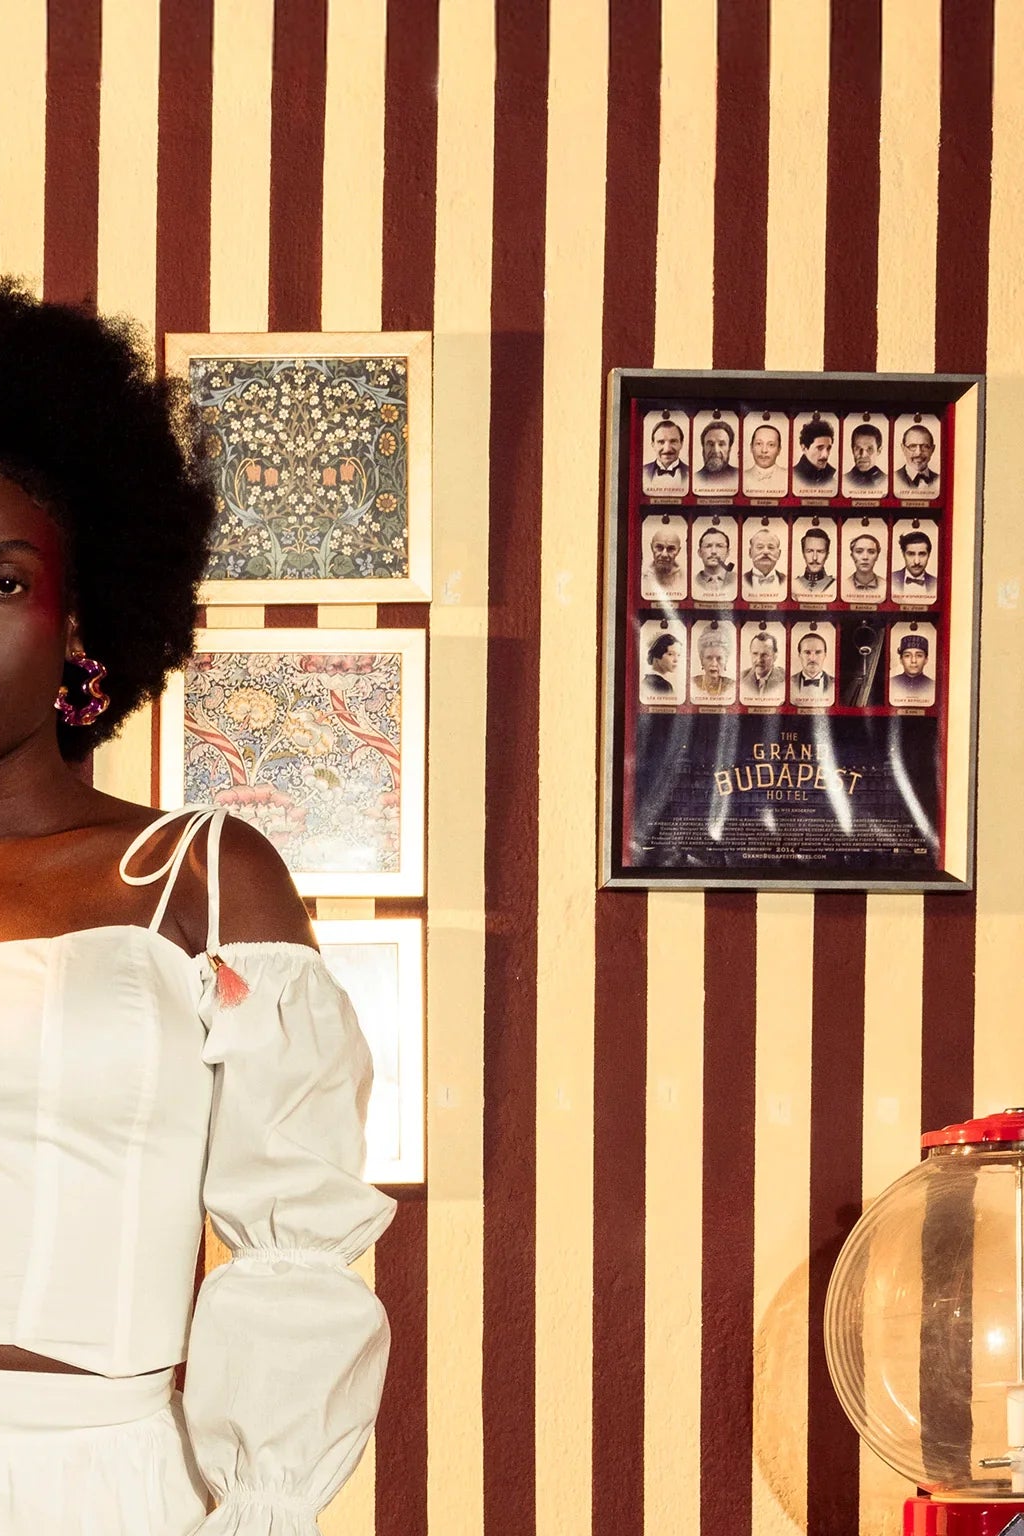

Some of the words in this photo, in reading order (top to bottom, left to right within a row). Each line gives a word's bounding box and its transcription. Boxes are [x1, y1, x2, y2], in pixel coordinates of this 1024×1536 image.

[781, 732, 798, 741] THE
[713, 763, 863, 796] BUDAPEST
[766, 790, 809, 800] HOTEL
